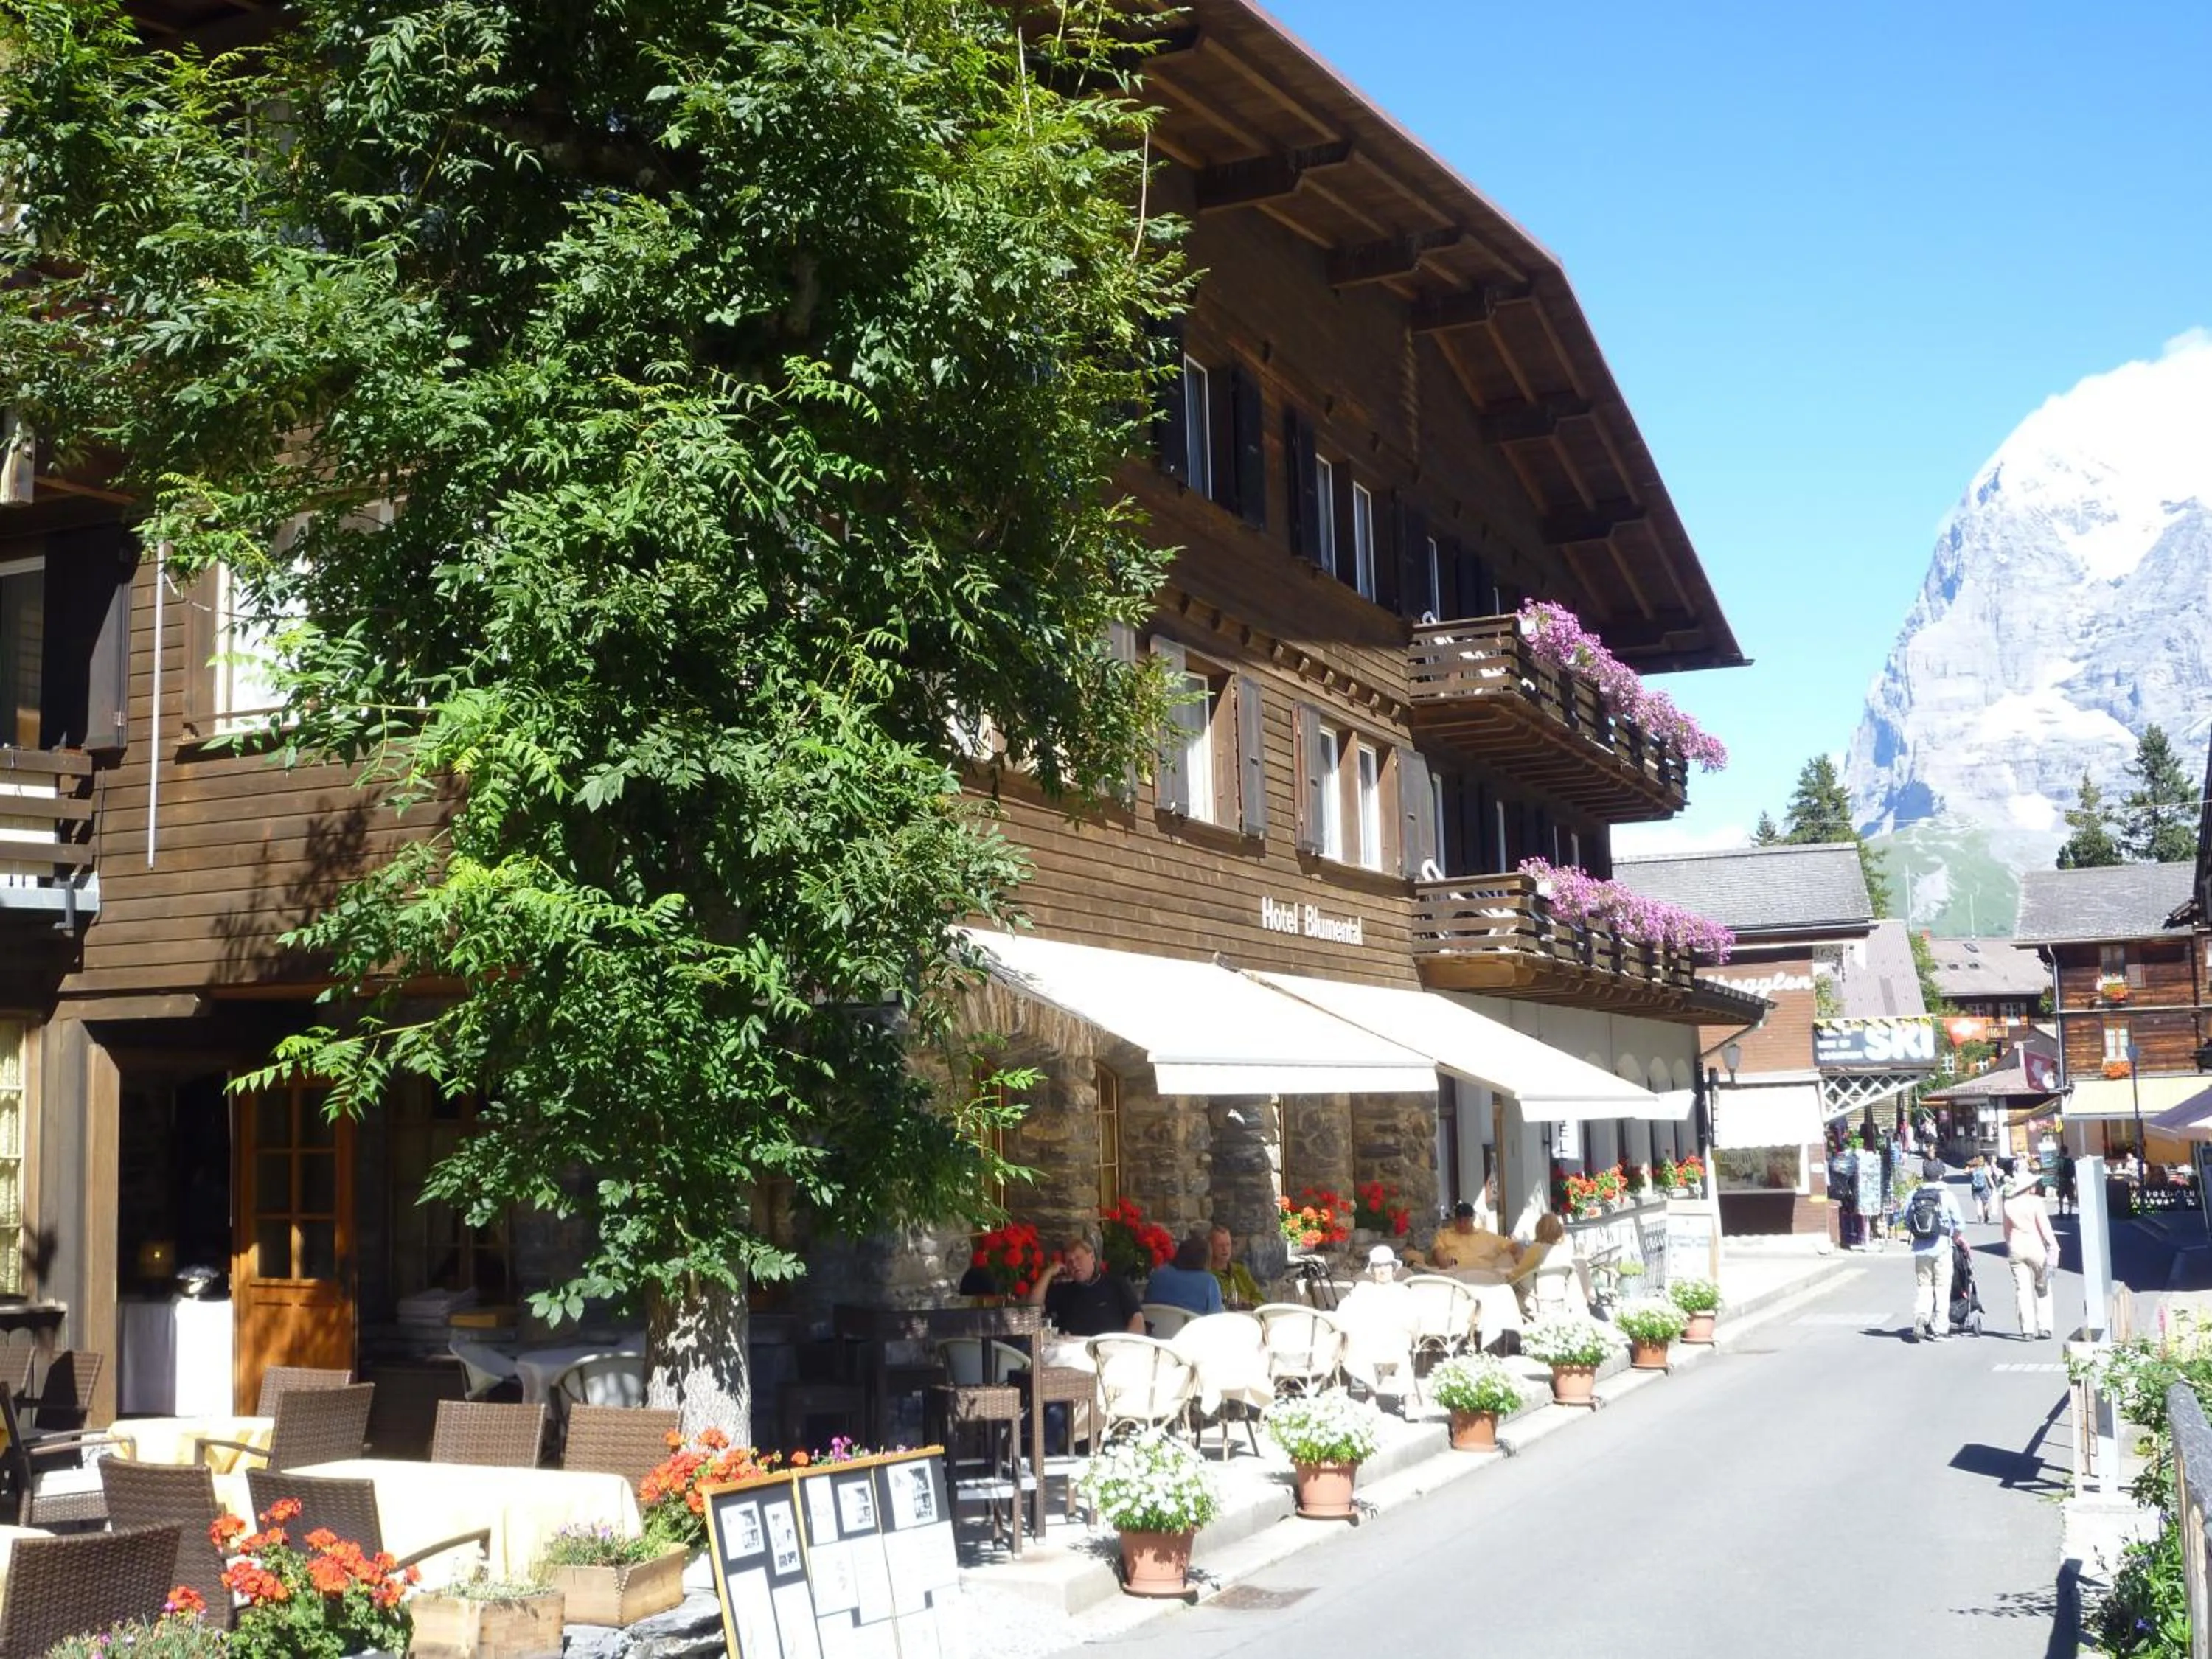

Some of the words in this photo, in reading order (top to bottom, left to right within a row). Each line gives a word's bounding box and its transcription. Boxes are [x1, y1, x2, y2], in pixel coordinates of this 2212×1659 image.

[1262, 896, 1298, 933] Hotel
[1304, 904, 1363, 946] Blumental
[1705, 971, 1814, 998] egglen
[1864, 1020, 1935, 1061] SKI
